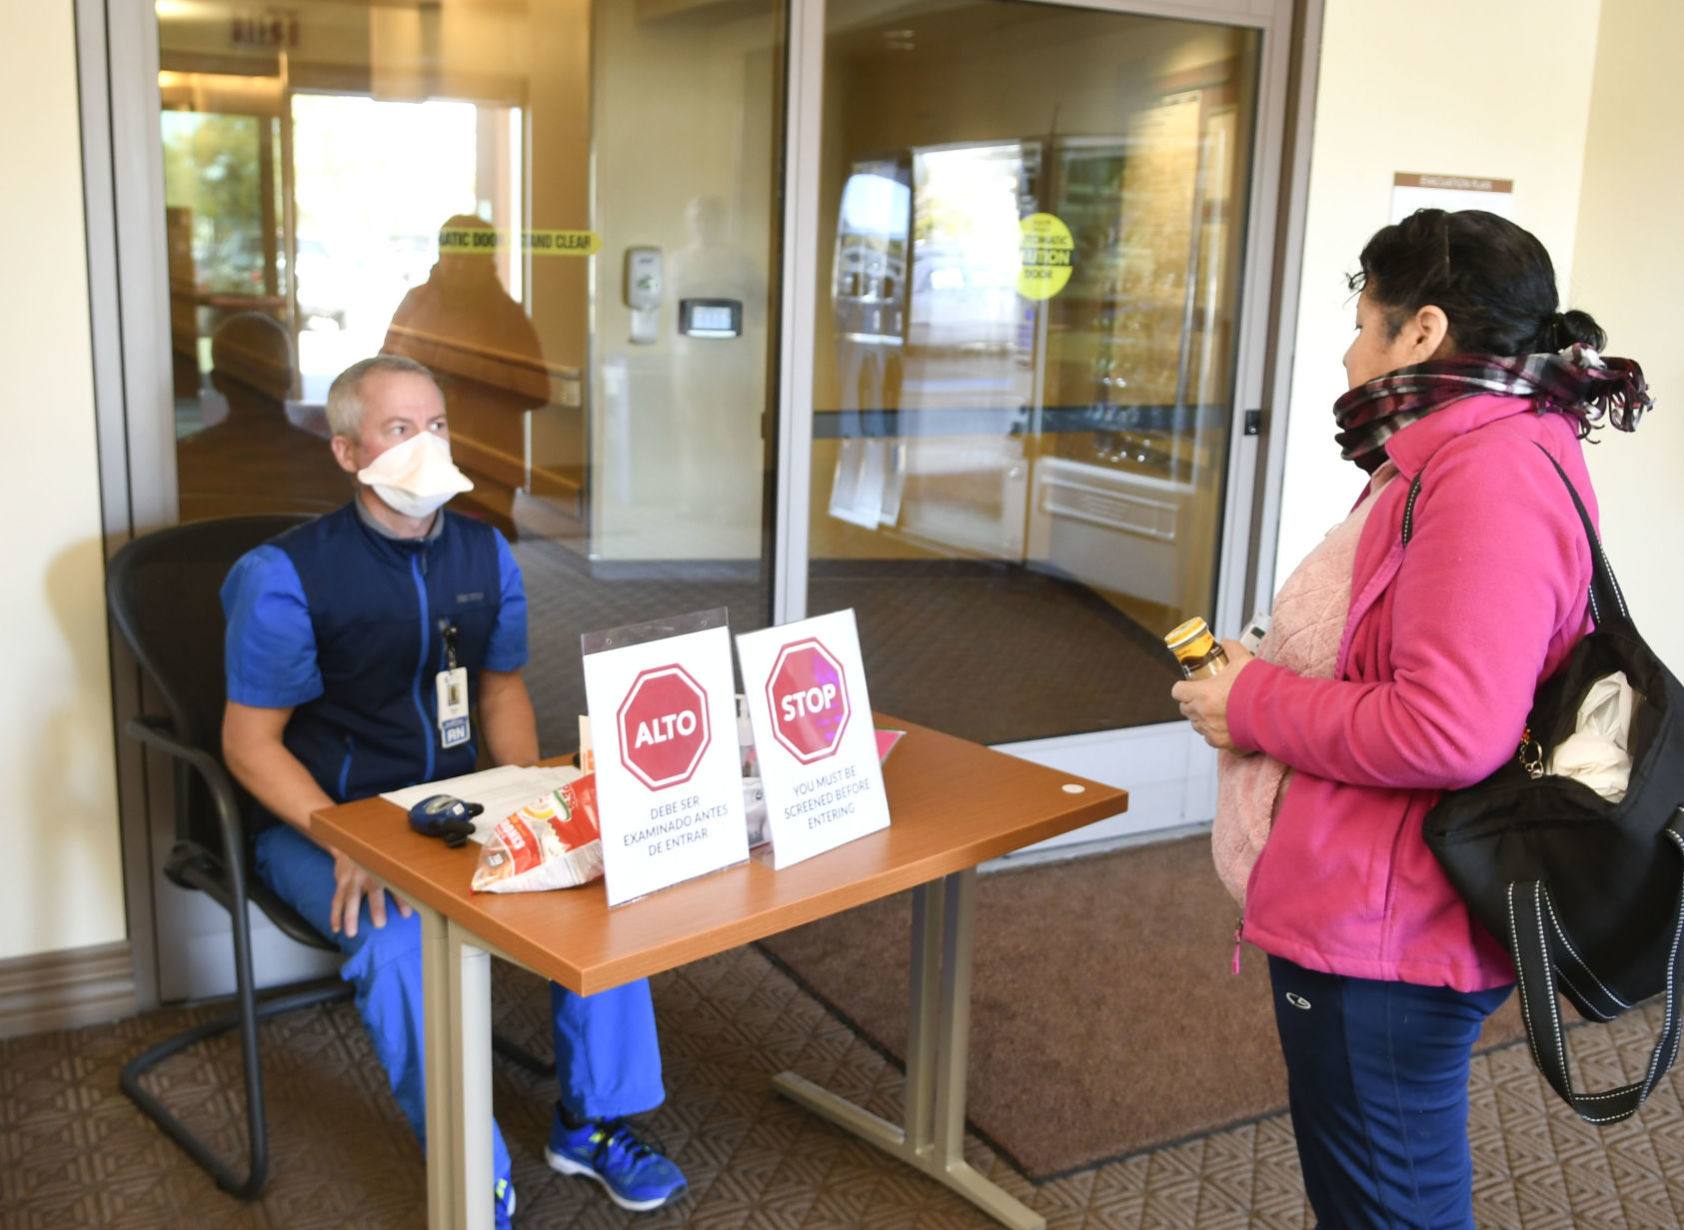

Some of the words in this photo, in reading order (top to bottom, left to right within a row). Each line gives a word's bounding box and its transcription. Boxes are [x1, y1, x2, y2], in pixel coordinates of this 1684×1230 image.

[555, 233, 592, 249] CLEAR
[781, 683, 837, 722] STOP
[634, 710, 697, 749] ALTO
[793, 780, 815, 797] YOU
[816, 770, 843, 789] MUST
[844, 765, 856, 779] BE
[650, 801, 678, 820] DEBE
[680, 795, 700, 811] SER
[784, 791, 834, 820] SCREENED
[835, 778, 870, 801] BEFORE
[623, 815, 692, 847] EXAMINADO
[694, 805, 729, 823] ANTES
[807, 802, 855, 830] ENTERING
[648, 841, 663, 857] DE
[665, 827, 708, 851] ENTRAR
